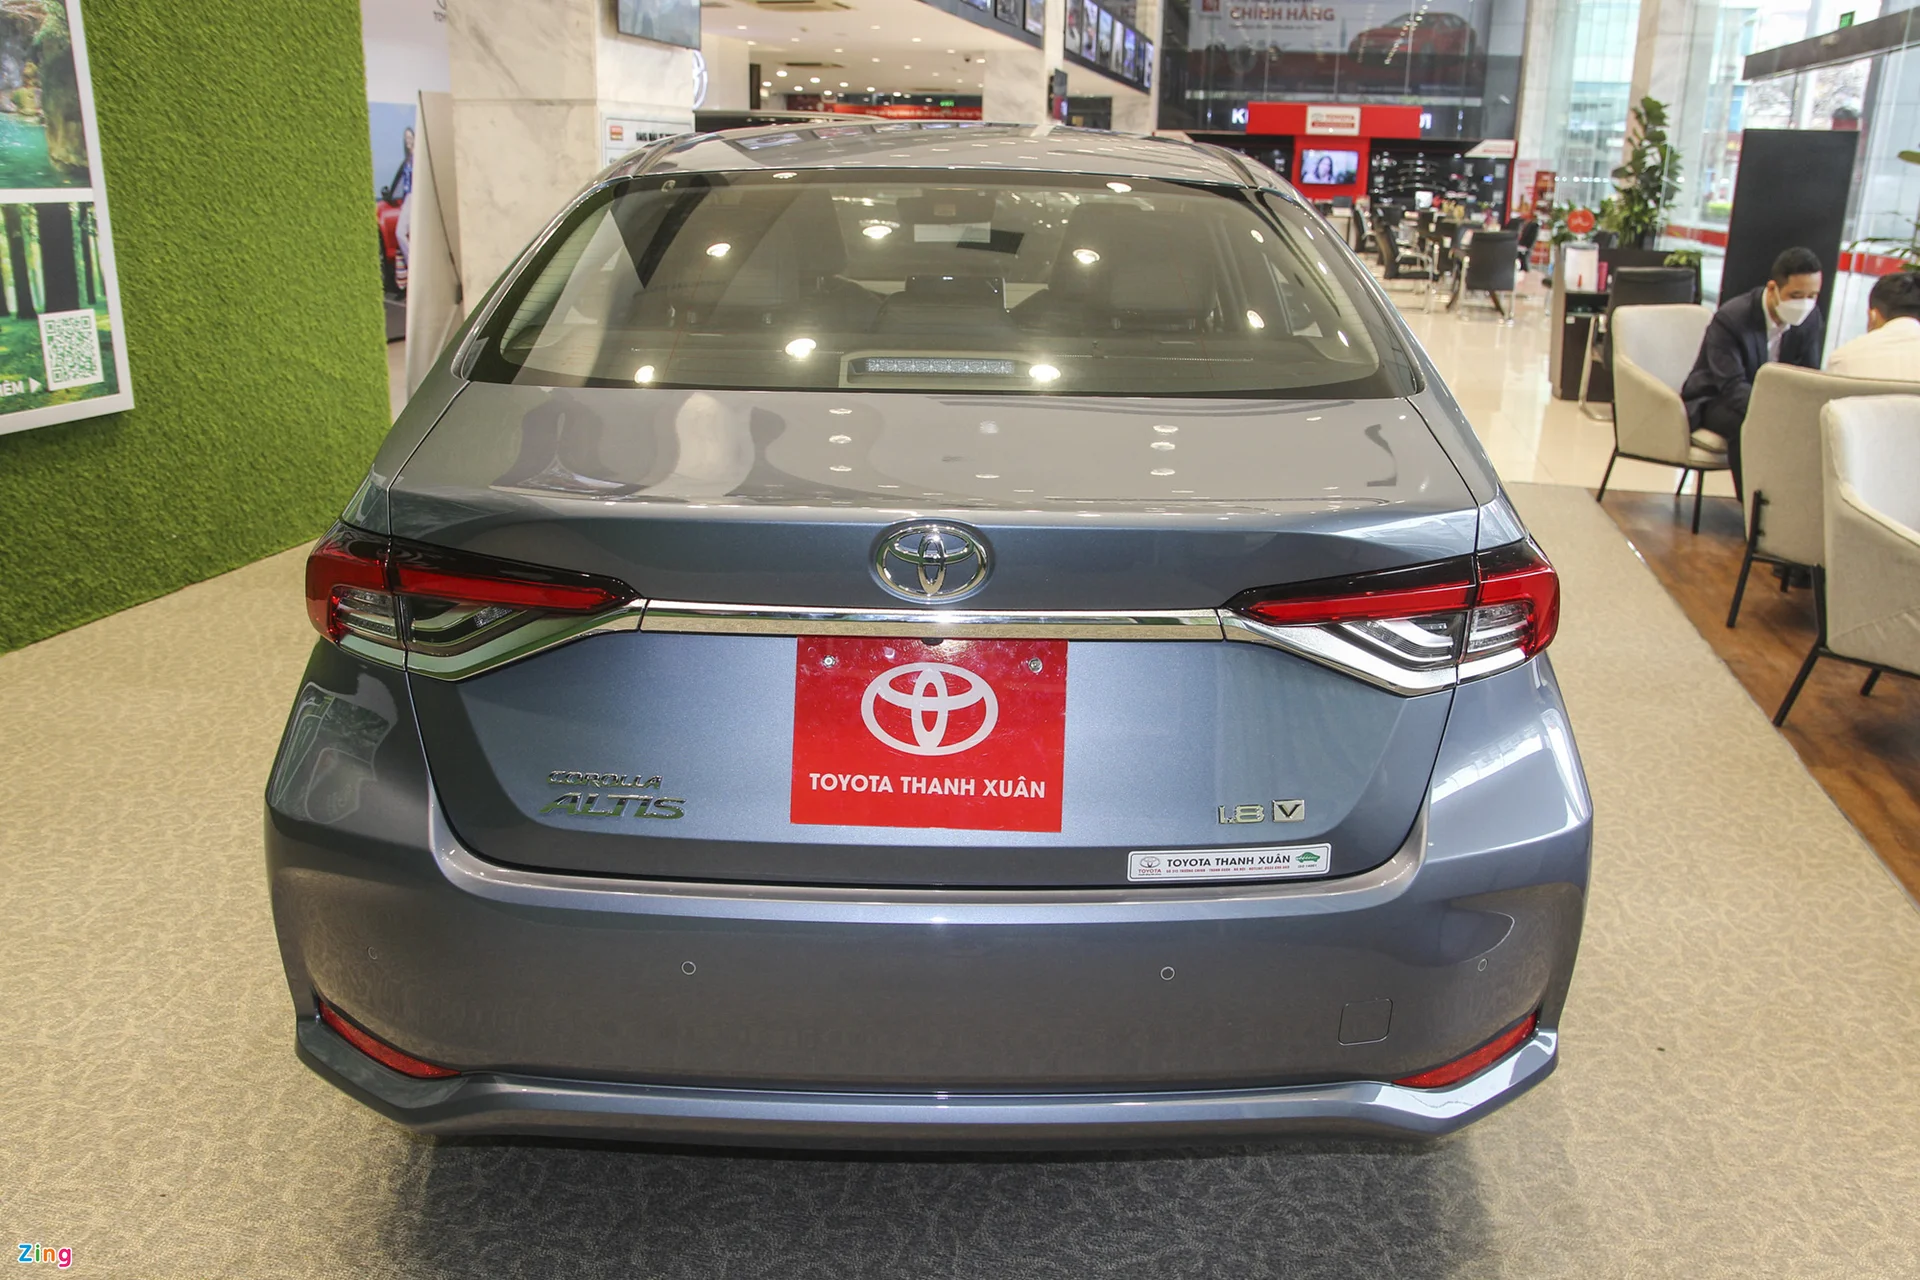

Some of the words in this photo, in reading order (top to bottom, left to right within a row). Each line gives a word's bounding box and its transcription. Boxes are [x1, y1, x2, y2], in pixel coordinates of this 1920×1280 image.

[547, 770, 663, 789] COROLLA
[809, 773, 893, 793] TOYOTA
[900, 776, 975, 796] THANH
[982, 775, 1045, 798] XUÂN
[539, 792, 687, 820] ALTIS
[1217, 804, 1265, 824] 1.8
[1274, 801, 1304, 820] V
[1167, 858, 1211, 867] TOYOTA
[1215, 856, 1254, 867] THANH
[1258, 853, 1290, 864] XUÂN
